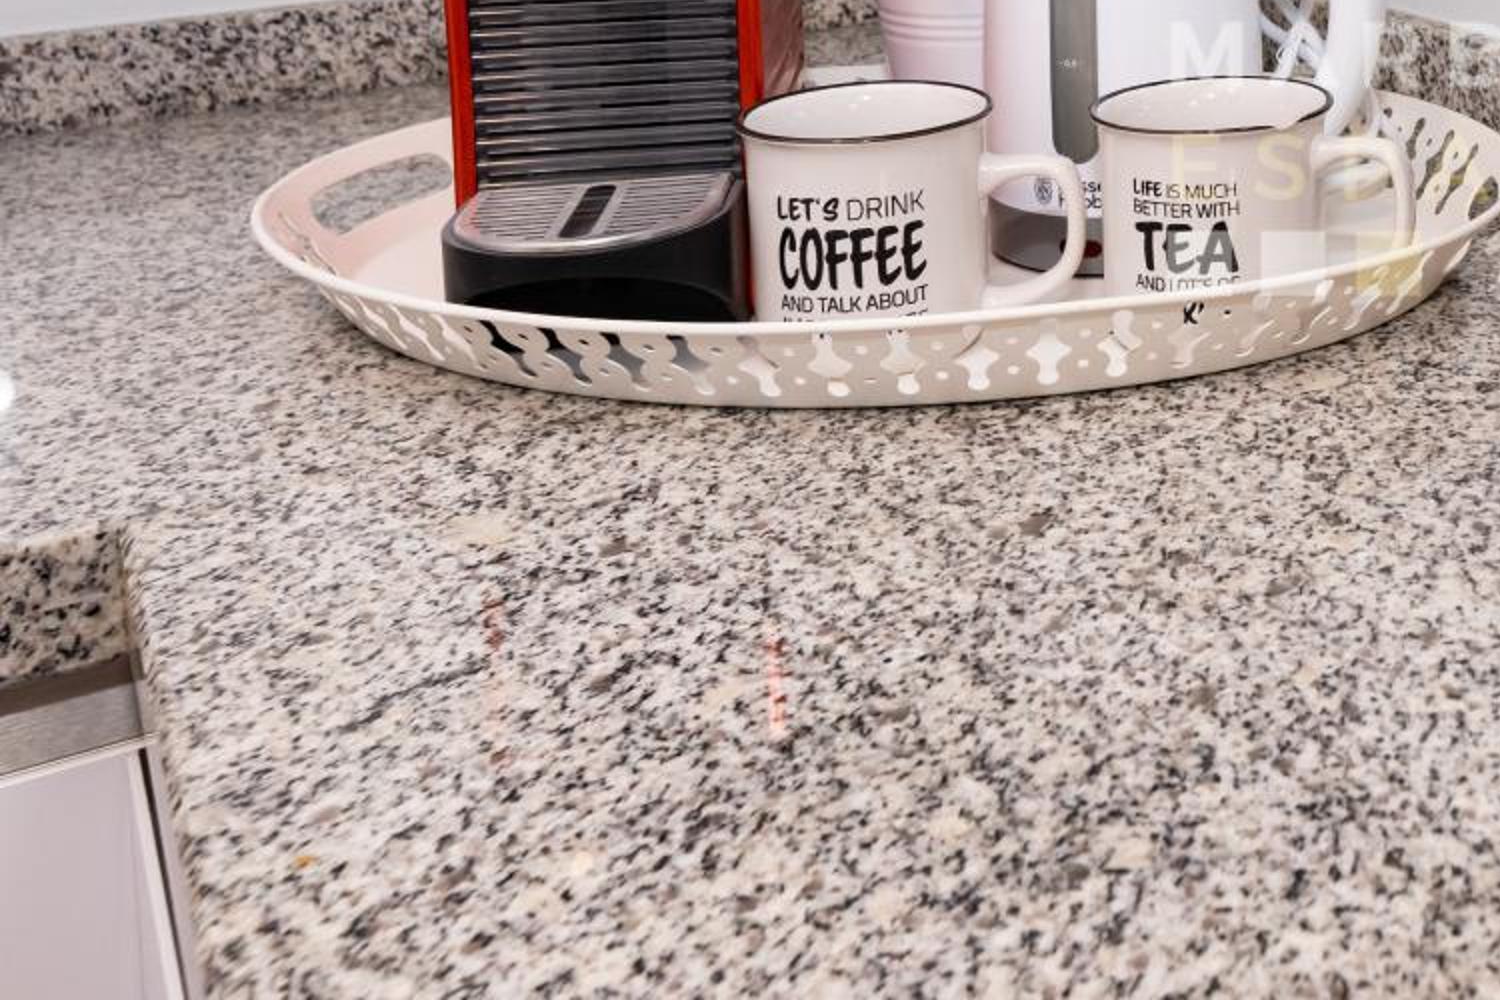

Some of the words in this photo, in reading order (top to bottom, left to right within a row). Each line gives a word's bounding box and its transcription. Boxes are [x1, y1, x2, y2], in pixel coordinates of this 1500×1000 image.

[1133, 178, 1163, 197] LIFE
[1166, 184, 1181, 199] IS
[1185, 182, 1237, 200] MUCH
[777, 195, 840, 222] LET'S
[847, 189, 926, 222] DRINK
[1133, 198, 1192, 218] BETTER
[1196, 201, 1240, 219] WITH
[778, 219, 928, 291] COFFEE
[1135, 220, 1240, 276] TEA
[1136, 274, 1166, 293] AND
[782, 294, 815, 313] AND
[817, 296, 862, 313] TALK
[866, 284, 928, 312] ABOUT
